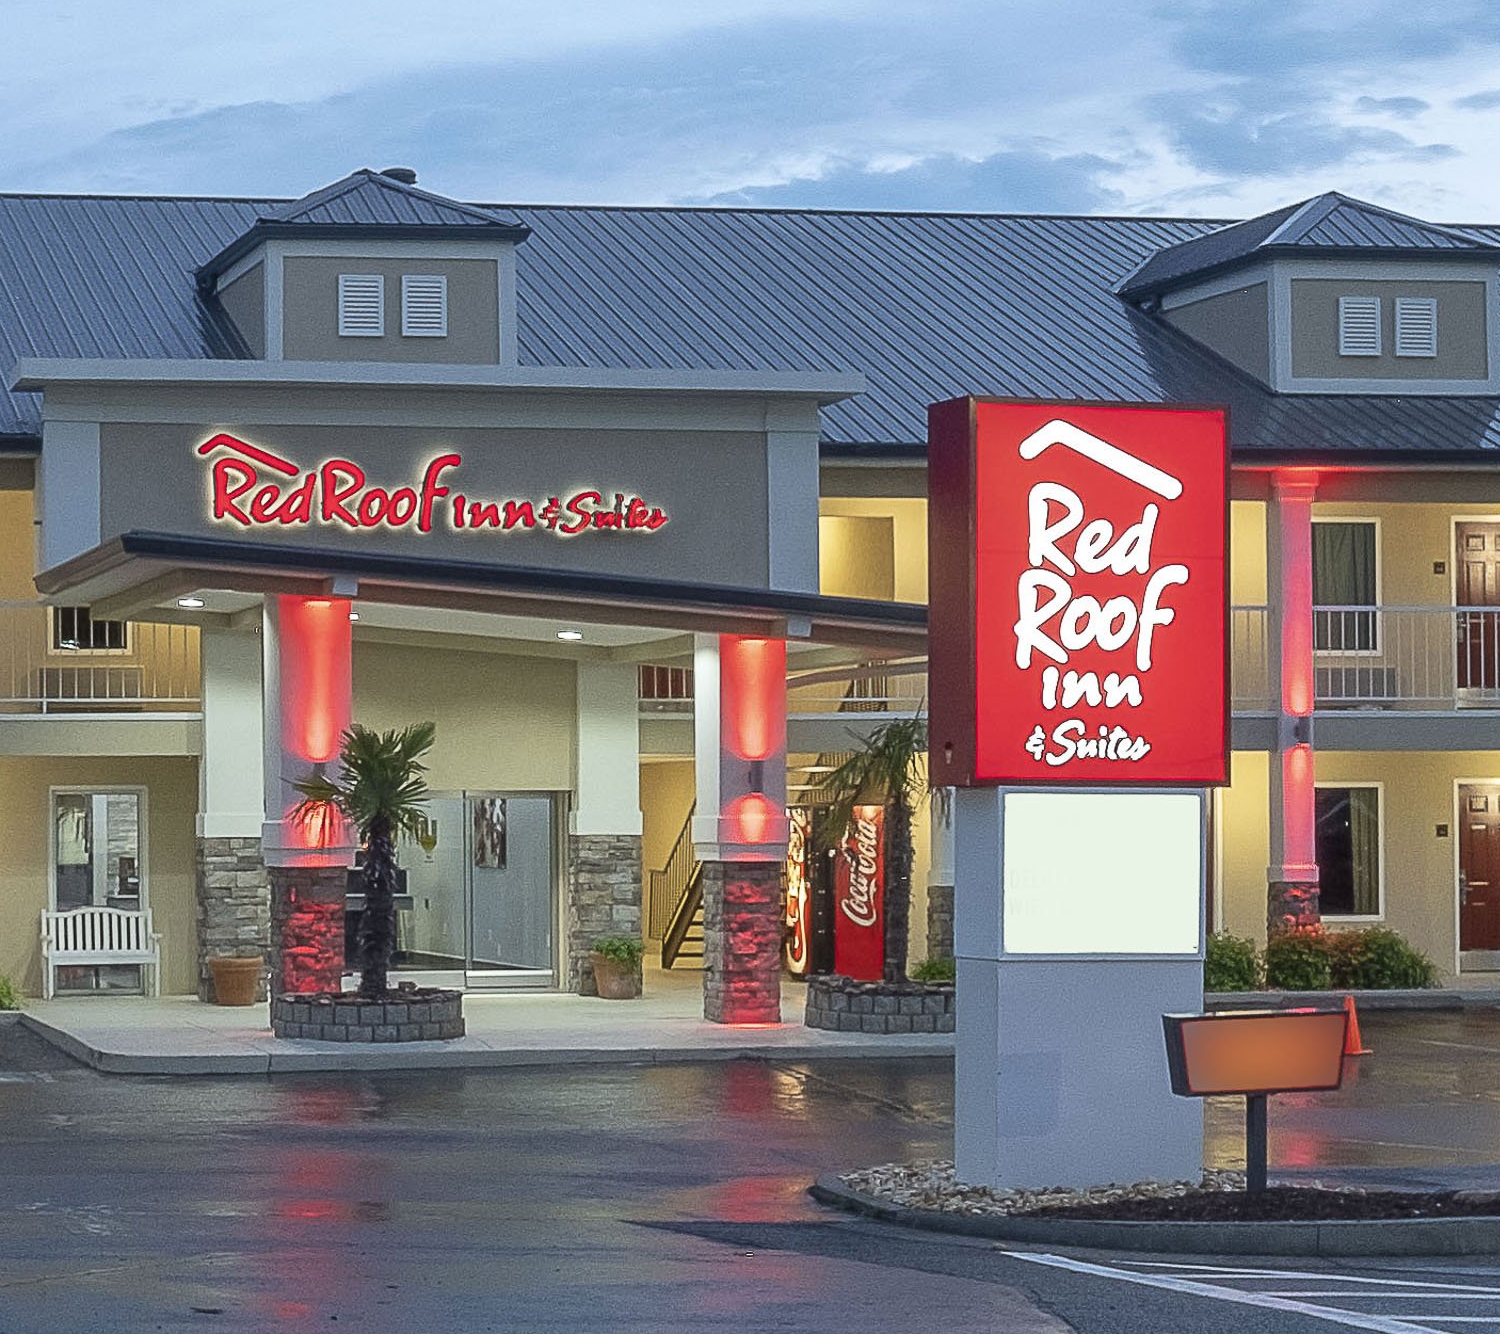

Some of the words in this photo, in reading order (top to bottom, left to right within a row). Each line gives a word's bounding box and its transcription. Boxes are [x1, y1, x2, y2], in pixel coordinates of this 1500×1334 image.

[214, 458, 316, 527] Red
[321, 453, 462, 534] Roof
[559, 491, 669, 534] Suites
[1027, 481, 1160, 577] Red
[1013, 564, 1190, 672] Roof
[1042, 665, 1144, 710] Inn
[1045, 718, 1152, 767] Suites
